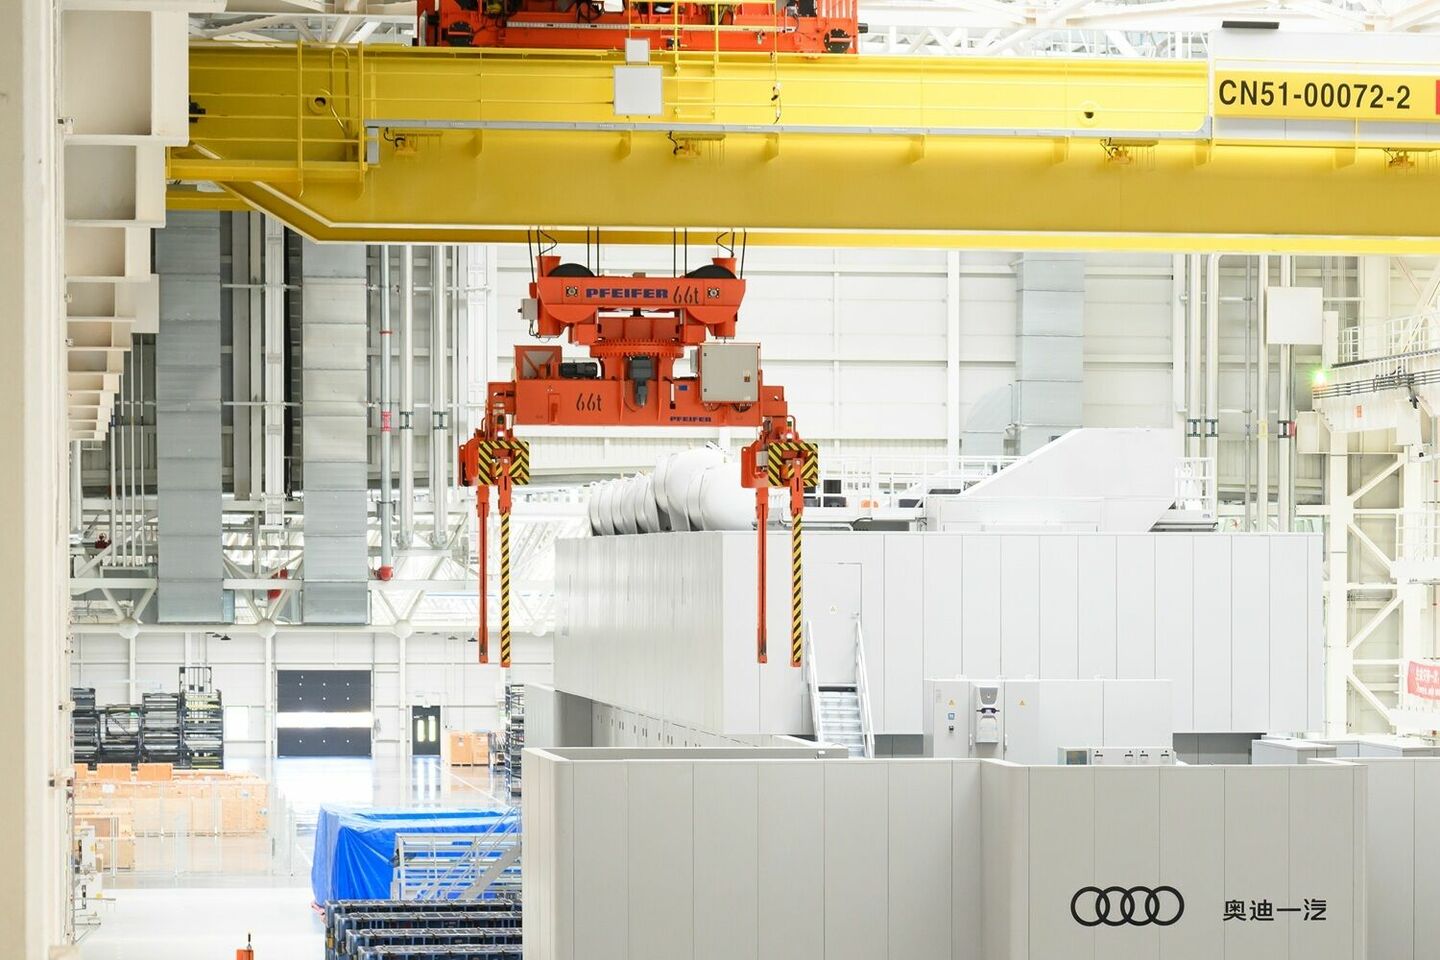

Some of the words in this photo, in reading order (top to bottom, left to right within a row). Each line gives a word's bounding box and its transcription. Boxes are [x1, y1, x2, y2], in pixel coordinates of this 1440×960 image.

[1218, 79, 1411, 110] CN51-00072-2
[586, 287, 669, 299] PFEIFER
[672, 286, 699, 305] 66t
[576, 392, 602, 412] 66t
[670, 415, 712, 423] PFEIFER
[1222, 898, 1328, 922] 奥迪一汽
